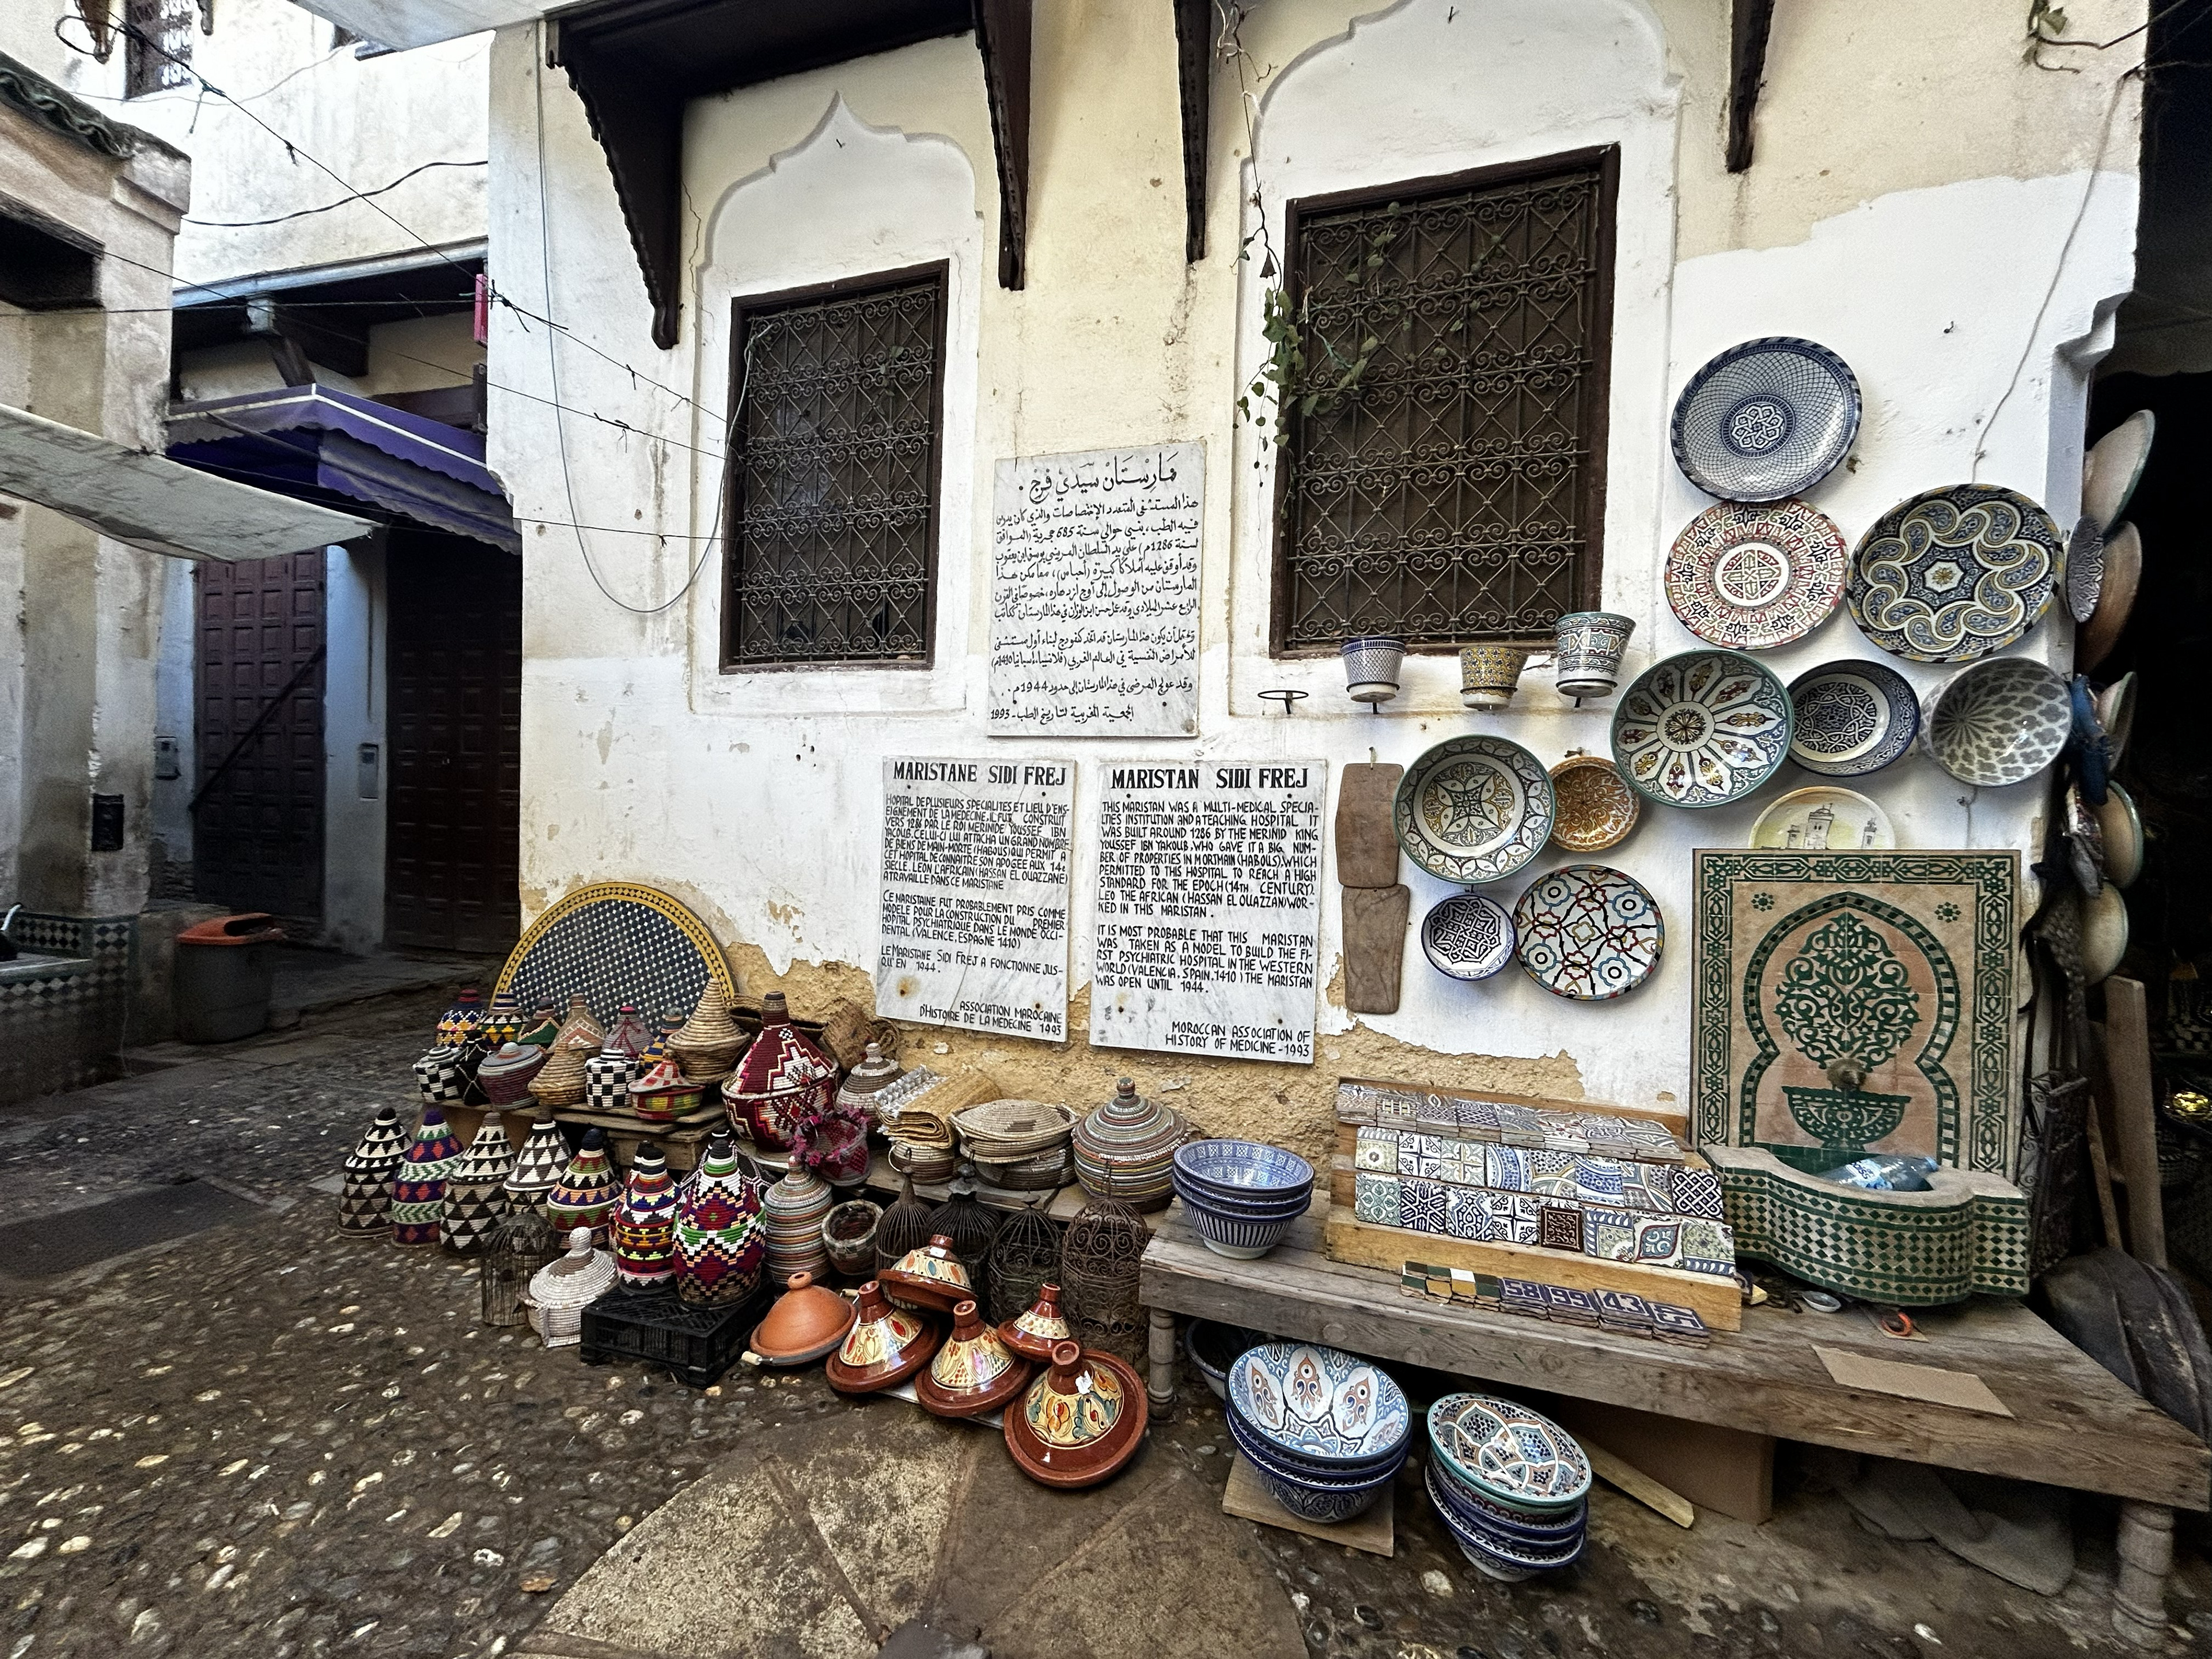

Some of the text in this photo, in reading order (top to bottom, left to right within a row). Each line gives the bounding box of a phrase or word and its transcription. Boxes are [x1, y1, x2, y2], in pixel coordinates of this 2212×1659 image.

[1106, 497, 1135, 514] المتعدد
[1182, 493, 1198, 509] هذا
[1013, 507, 1027, 525] كان
[1027, 507, 1050, 527] والذي
[1067, 650, 1092, 671] الغربي
[1092, 650, 1115, 672] العالم
[1116, 650, 1127, 668] في
[1128, 648, 1158, 664] النفسية
[1021, 680, 1048, 693] 1944
[1048, 683, 1069, 695] حدود
[1158, 677, 1174, 696] عولج
[1176, 677, 1192, 692] وقد
[990, 703, 1134, 725] الجمعية المغربية لتاريخ الطب 1993
[893, 761, 1066, 786] MARISTANE SIDI FREJ
[1111, 768, 1308, 789] MARISTAN SIDI FREJ
[885, 794, 914, 806] HOPITAL
[926, 796, 963, 809] PLUSIEURS
[965, 798, 1012, 812] SPECIALITES
[1013, 801, 1024, 813] ET
[1026, 802, 1043, 814] LIEU
[1102, 801, 1319, 813] THIS MARISTAN WAS A MULTI-MEDICAL SPECIA-
[885, 816, 904, 829] VERS
[925, 819, 939, 831] PAR
[941, 819, 950, 831] LE
[953, 820, 965, 832] ROI
[968, 821, 1005, 834] MERINIDE
[1008, 823, 1041, 836] YOUSSEF
[1051, 825, 1066, 838] IBN
[1101, 814, 1121, 826] LTIES
[1126, 814, 1173, 826] INSTITUTION
[1177, 814, 1194, 826] AND
[1201, 814, 1245, 826] TEACHING
[1251, 814, 1298, 826] HOSPITAL
[1309, 814, 1319, 826] IT
[1101, 827, 1319, 841] WAS BUILT AROUND 1286 BY THE MERINID KING
[1100, 864, 1316, 881] PERMITTED TO THIS HOSPITAL TO REACH A HIGH
[1100, 876, 1145, 891] STANDARD
[1152, 878, 1168, 891] FOR
[1172, 878, 1187, 892] THE
[883, 889, 893, 903] CE
[939, 896, 952, 908] FUT
[956, 897, 1013, 915] PROBABLEMENT
[1017, 904, 1034, 916] PRIS
[1038, 906, 1065, 919] COMME
[882, 903, 1065, 930] MODELE POUR LA CONSTRUCTION DU PREMIER
[881, 913, 1063, 941] HOPITAL PSYCHIATRIQUE DANS LE MONDE OCCI-
[881, 923, 910, 938] DENTAL
[958, 931, 994, 946] ESPAGNE
[997, 935, 1020, 949] 1410)
[1098, 923, 1313, 947] IT IS MOST PROBABLE THAT THIS MARISTAN
[1096, 949, 1312, 974] RST PSYCHIATRIC HOSPITAL IN THE WESTERN
[1096, 974, 1114, 987] WAS
[1118, 975, 1141, 988] OPEN
[1147, 977, 1172, 991] UNTIL
[960, 1000, 1062, 1024] ASSOCIATION MAROCAINE
[964, 1012, 975, 1024] DE
[979, 1014, 990, 1027] LA
[992, 1016, 1031, 1032] MEDECINE
[1039, 1021, 1060, 1036] 1993
[1172, 1021, 1310, 1043] MOROCCAN ASSOCIATION OF
[1165, 1033, 1208, 1050] HISTORY
[1214, 1037, 1226, 1051] OF
[1229, 1037, 1275, 1054] MEDICINE
[1505, 1280, 1540, 1297] 58
[1550, 1287, 1591, 1309] 99
[1603, 1292, 1641, 1313] 43
